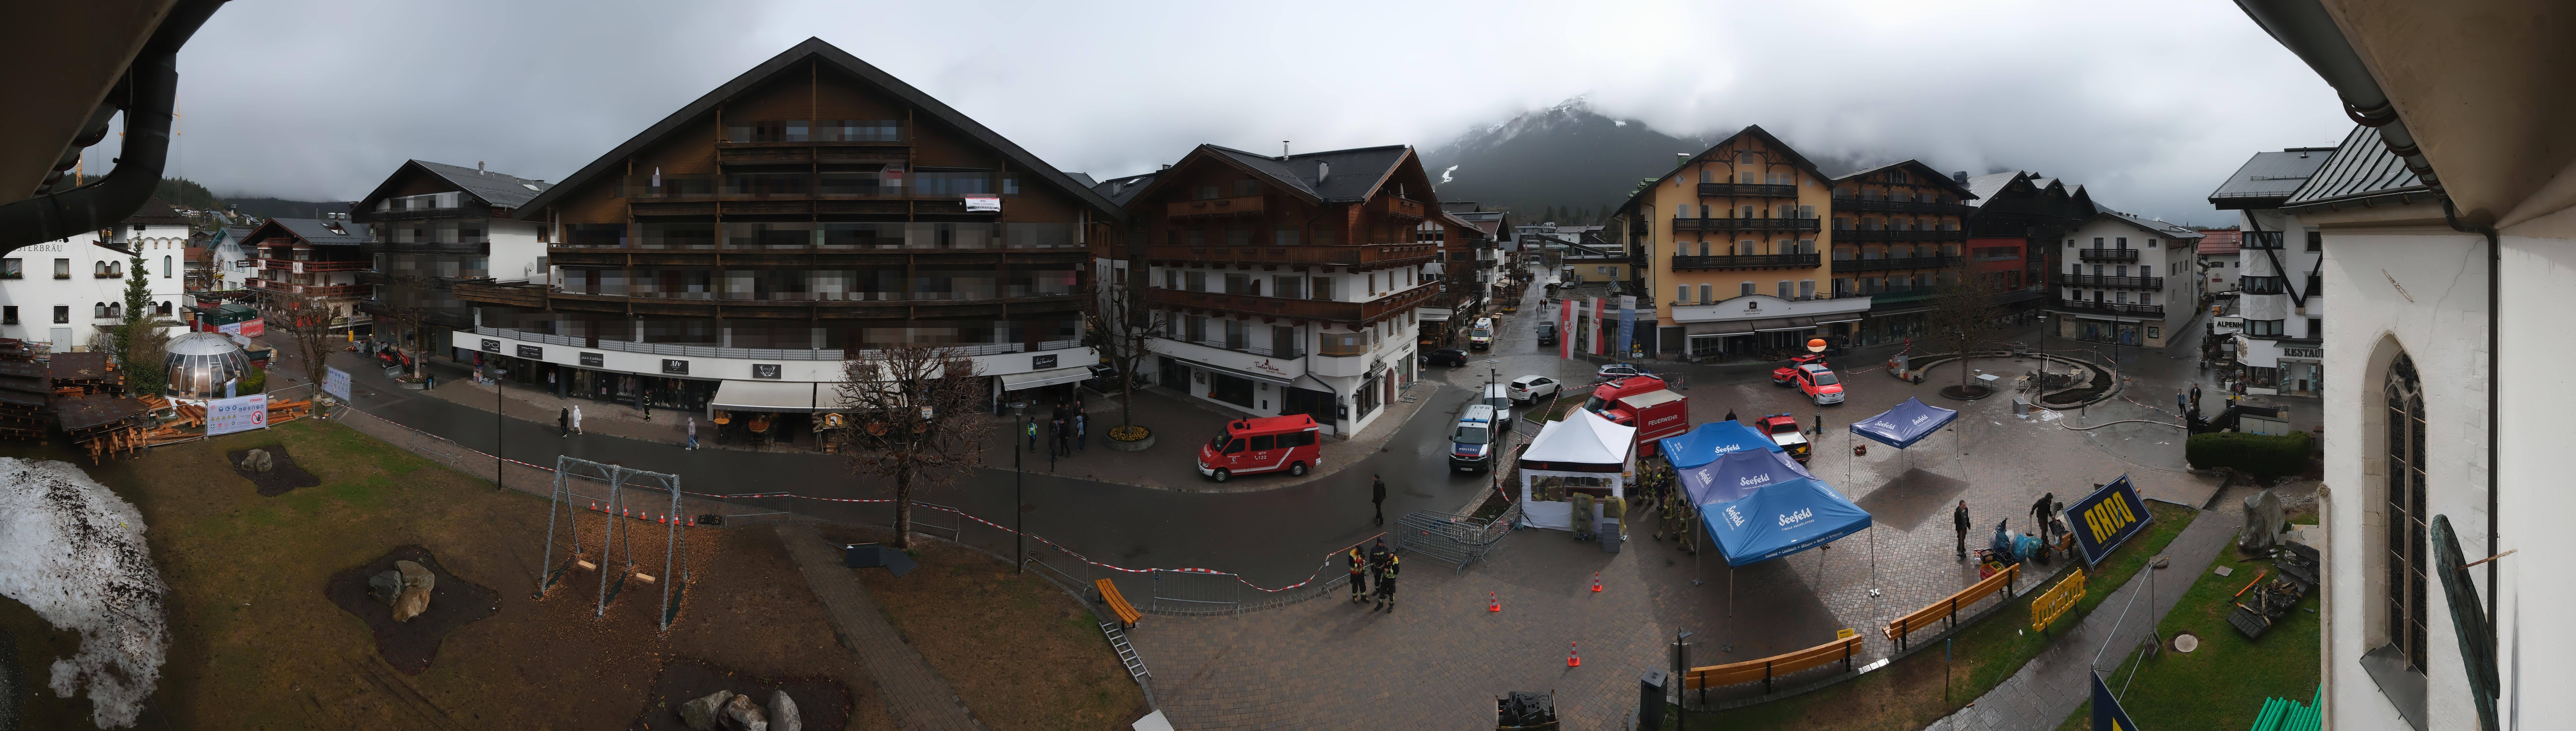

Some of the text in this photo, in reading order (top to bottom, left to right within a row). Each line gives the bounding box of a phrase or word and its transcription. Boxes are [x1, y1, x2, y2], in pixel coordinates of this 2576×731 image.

[1402, 343, 1411, 352] SAILER
[670, 361, 681, 370] My
[1372, 364, 1385, 377] RESTAURANT
[1649, 415, 1677, 426] FEUERWEHR
[1912, 414, 1928, 425] Seefeld
[1875, 421, 1896, 430] Seefeld
[1715, 444, 1740, 452] Seefeld
[1699, 469, 1713, 485] Seefeld
[1740, 473, 1770, 486] Seefeld
[1726, 505, 1745, 527] Seefeld
[1779, 507, 1812, 526] Seefeld
[1725, 517, 1734, 531] HOCHPLATEAU
[1793, 519, 1815, 528] HOCHPLATEAU
